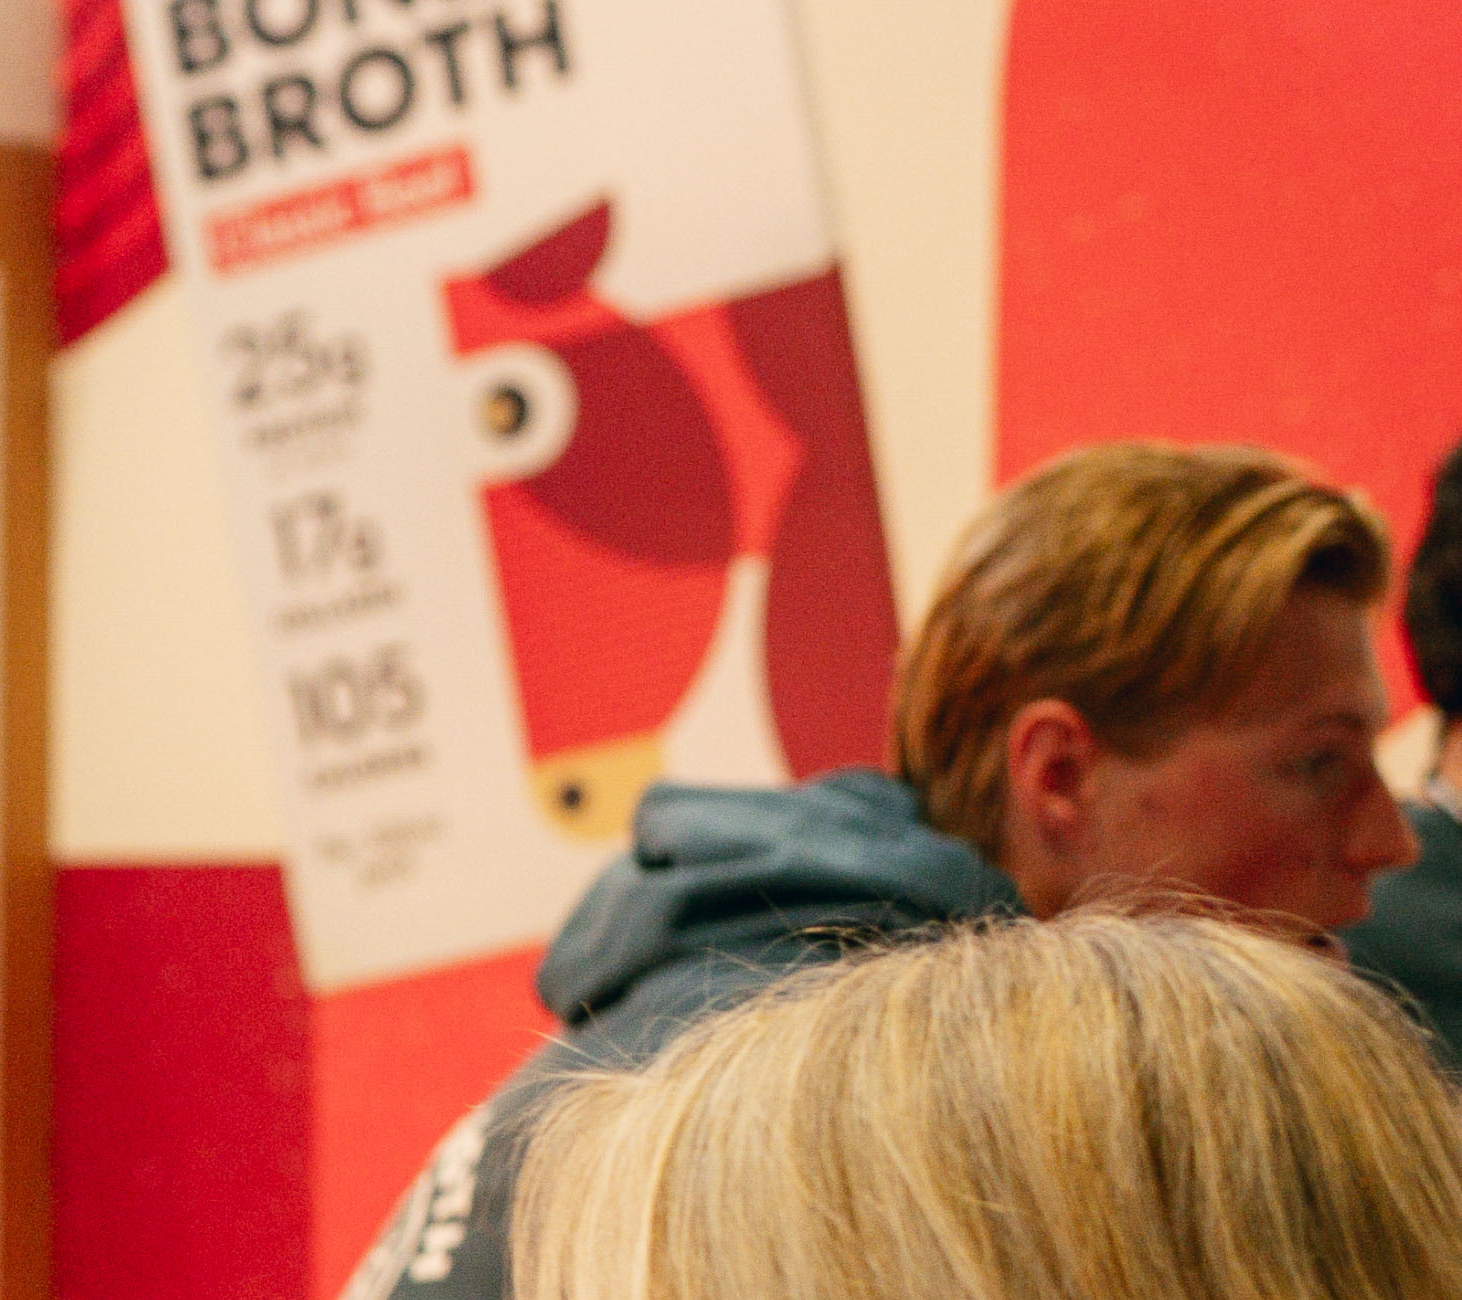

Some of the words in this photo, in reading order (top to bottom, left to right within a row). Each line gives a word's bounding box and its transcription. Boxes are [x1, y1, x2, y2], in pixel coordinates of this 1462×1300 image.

[172, 0, 417, 73] BO
[189, 0, 570, 182] BROTH
[287, 640, 426, 750] 105
